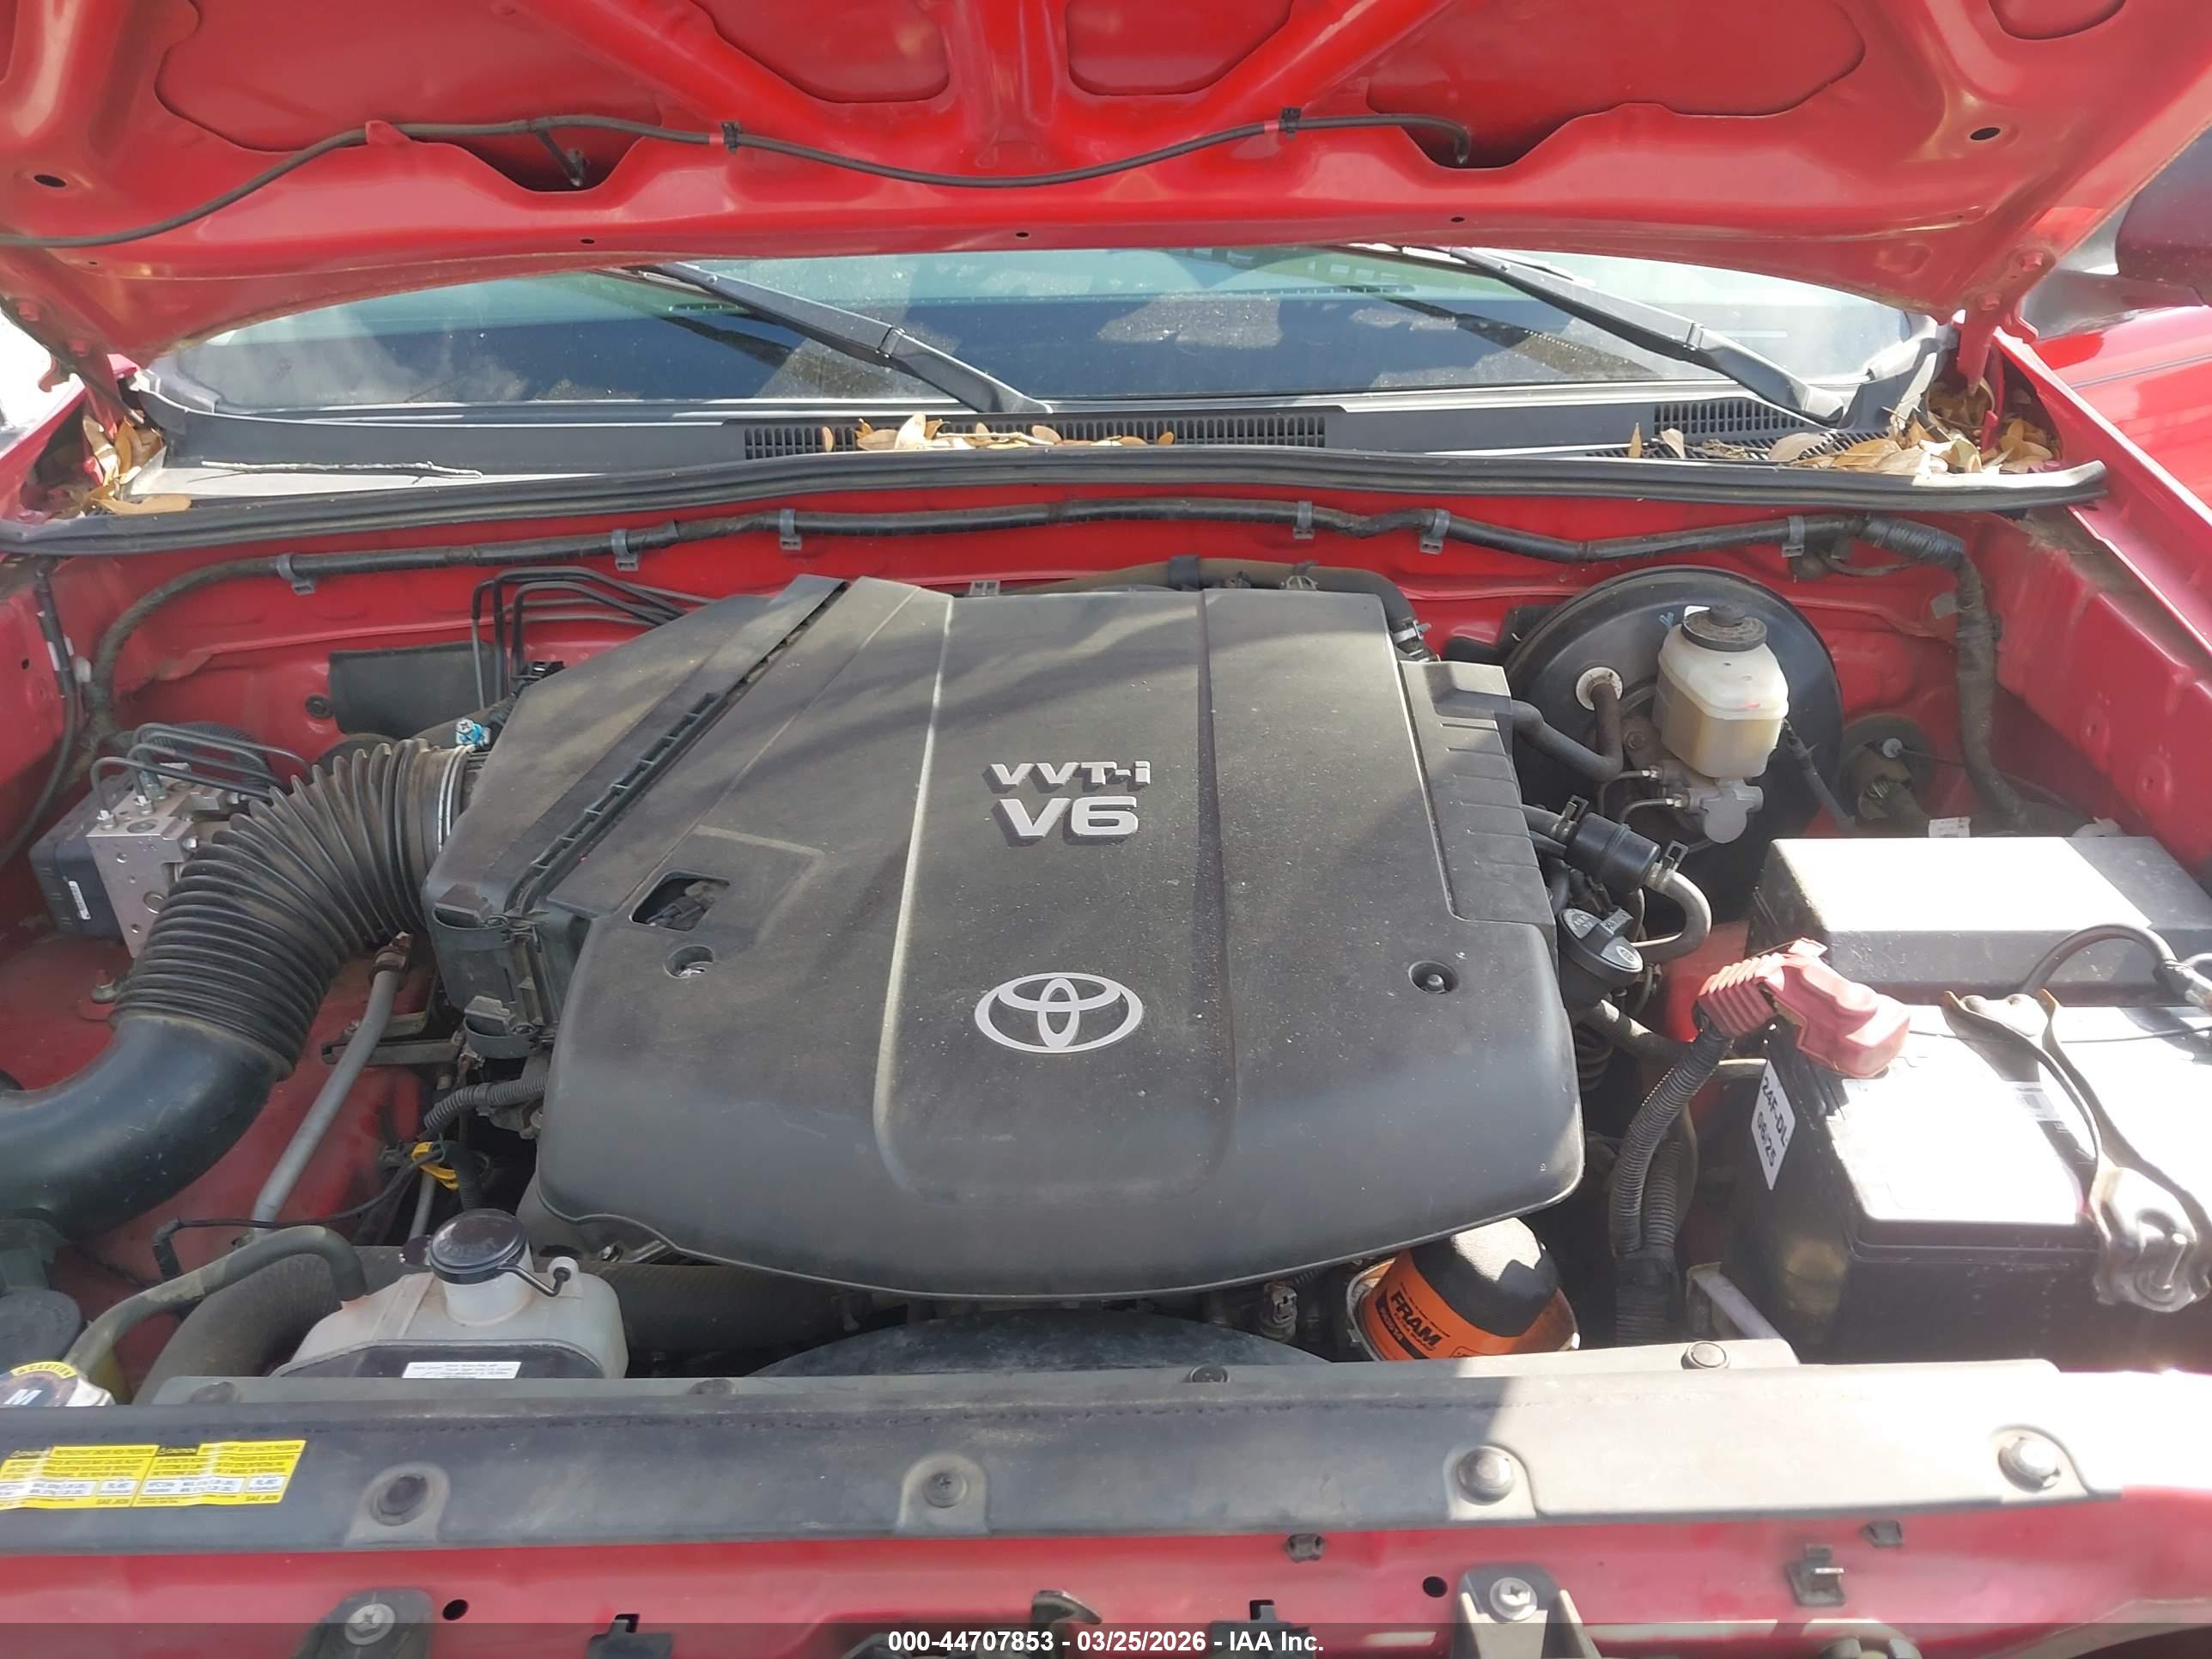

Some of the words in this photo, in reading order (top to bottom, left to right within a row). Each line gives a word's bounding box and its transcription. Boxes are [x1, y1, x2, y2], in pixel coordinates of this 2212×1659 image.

[989, 760, 1152, 786] VVT-i
[999, 795, 1139, 838] V6
[1761, 1075, 1788, 1148] 24F-DL
[1390, 1290, 1443, 1346] FRAM
